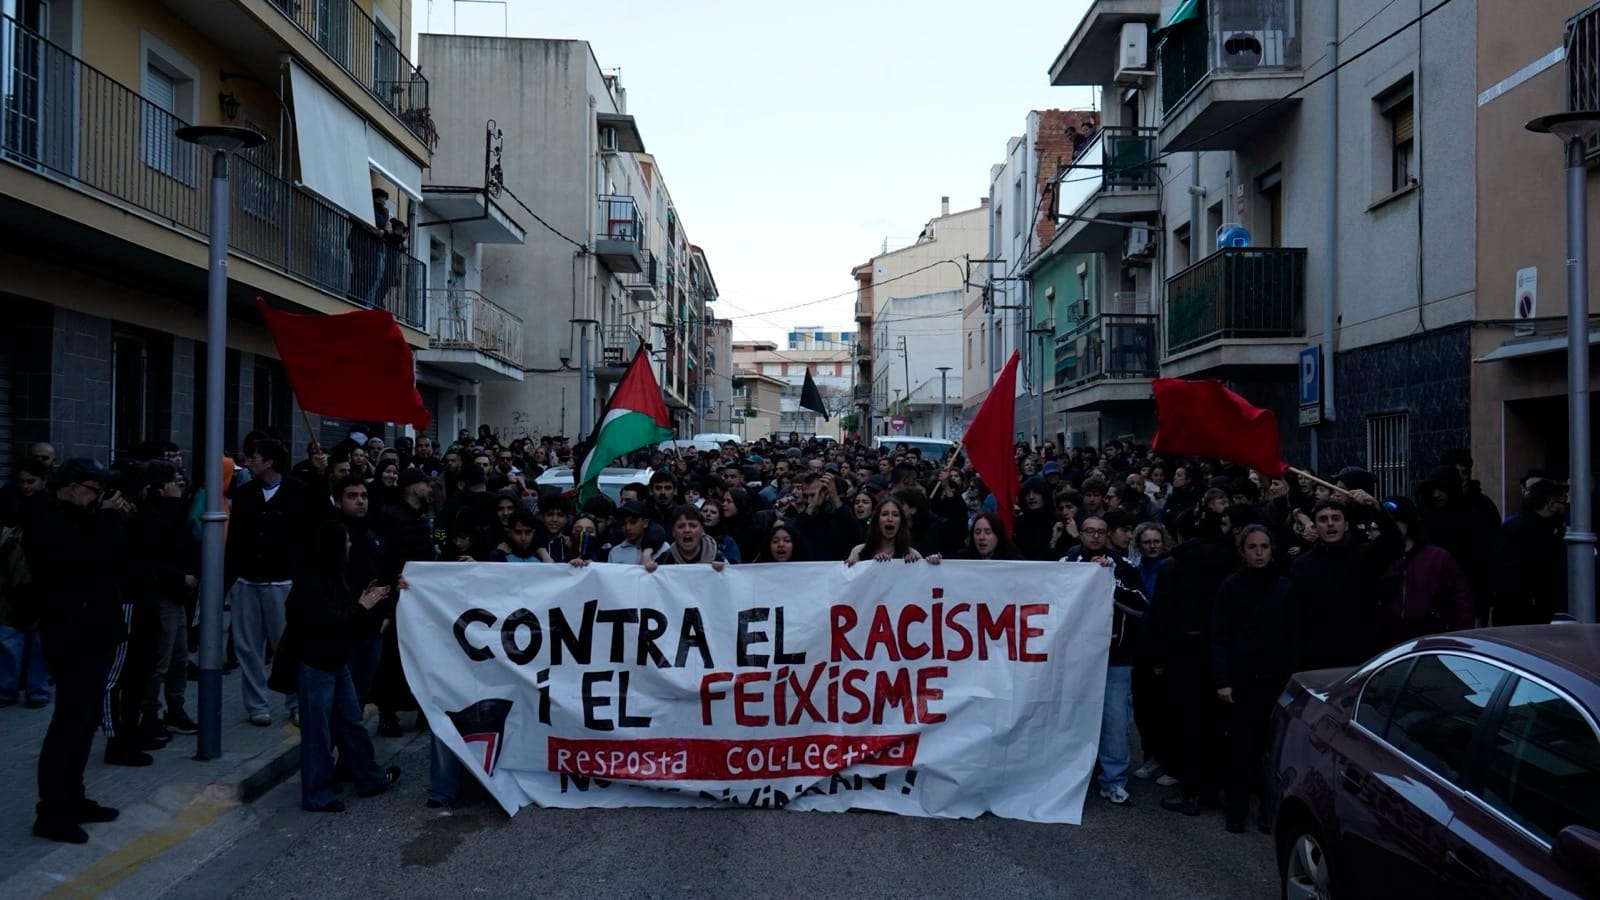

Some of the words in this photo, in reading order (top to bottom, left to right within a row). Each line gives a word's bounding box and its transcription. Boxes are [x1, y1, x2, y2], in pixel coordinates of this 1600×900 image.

[453, 600, 714, 668] CONTRA
[737, 607, 807, 668] EL
[830, 588, 1049, 662] RACiSME
[582, 671, 652, 731] EL
[701, 661, 948, 726] FEiXiSME
